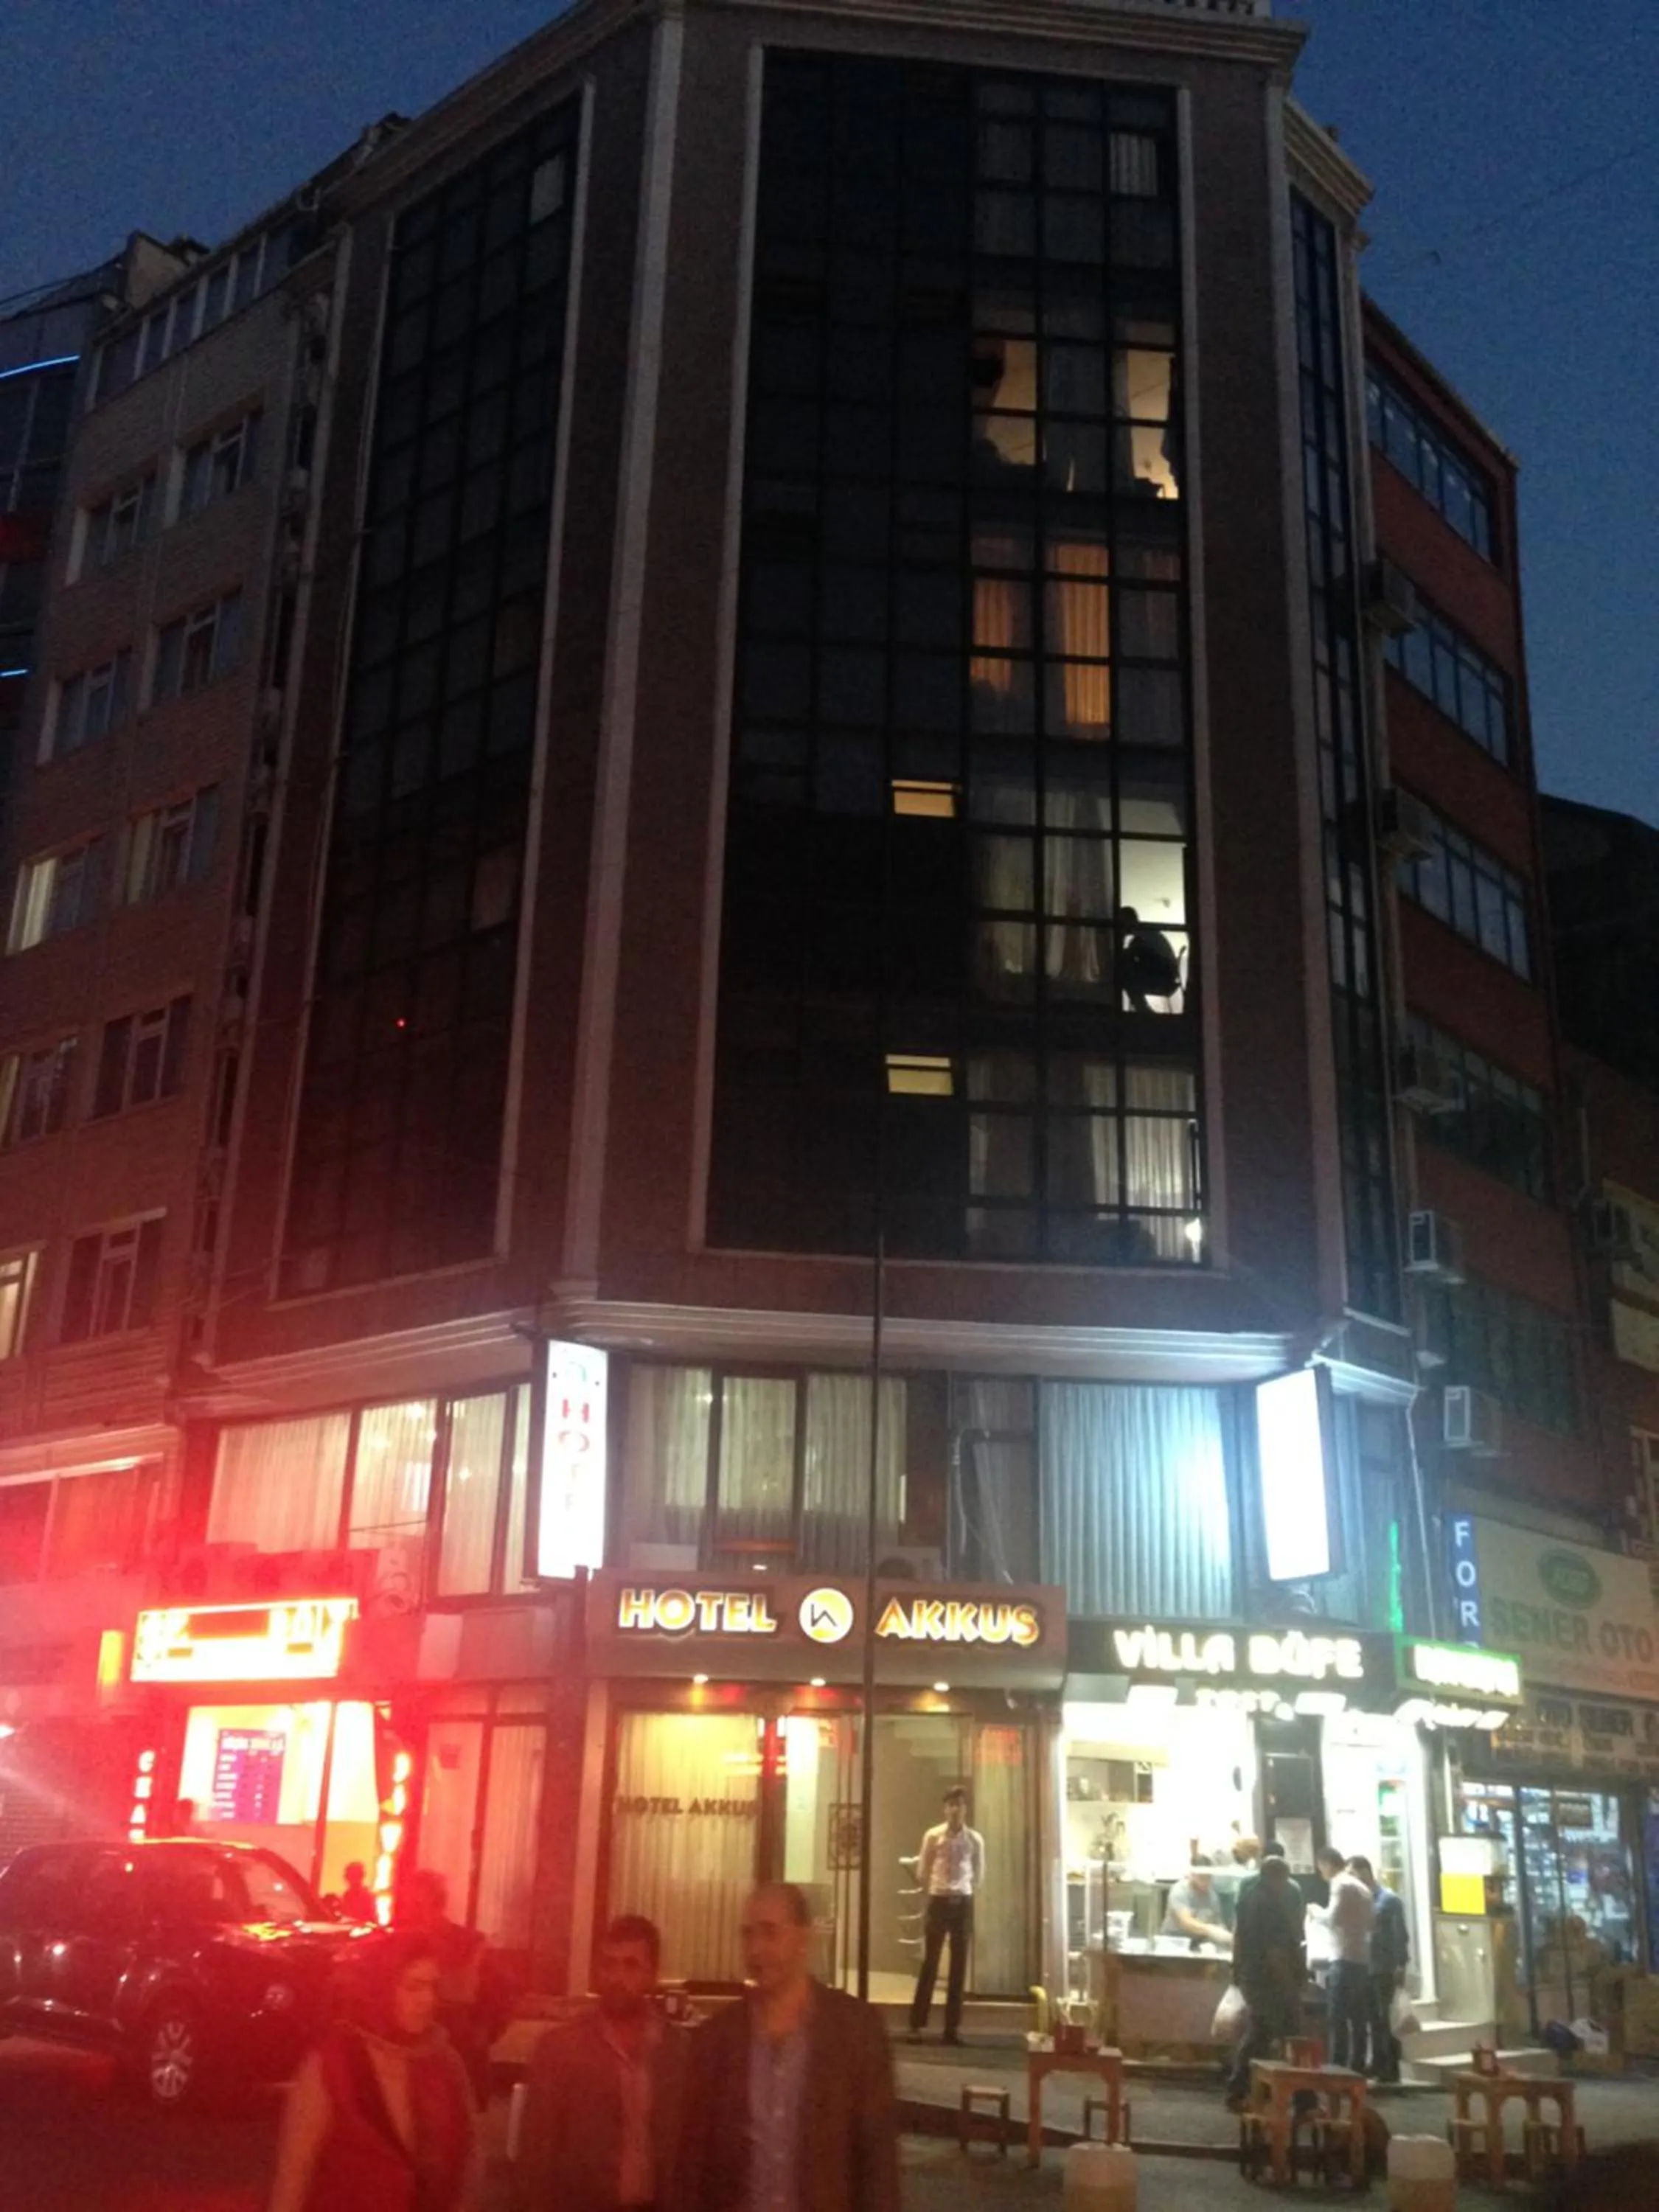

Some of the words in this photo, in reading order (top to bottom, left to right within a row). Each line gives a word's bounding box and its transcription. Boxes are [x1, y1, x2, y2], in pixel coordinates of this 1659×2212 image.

[1453, 1520, 1481, 1650] FOR
[618, 1589, 777, 1632] HOTEL
[1599, 1621, 1655, 1663] OTO
[616, 1796, 684, 1815] HOTEL
